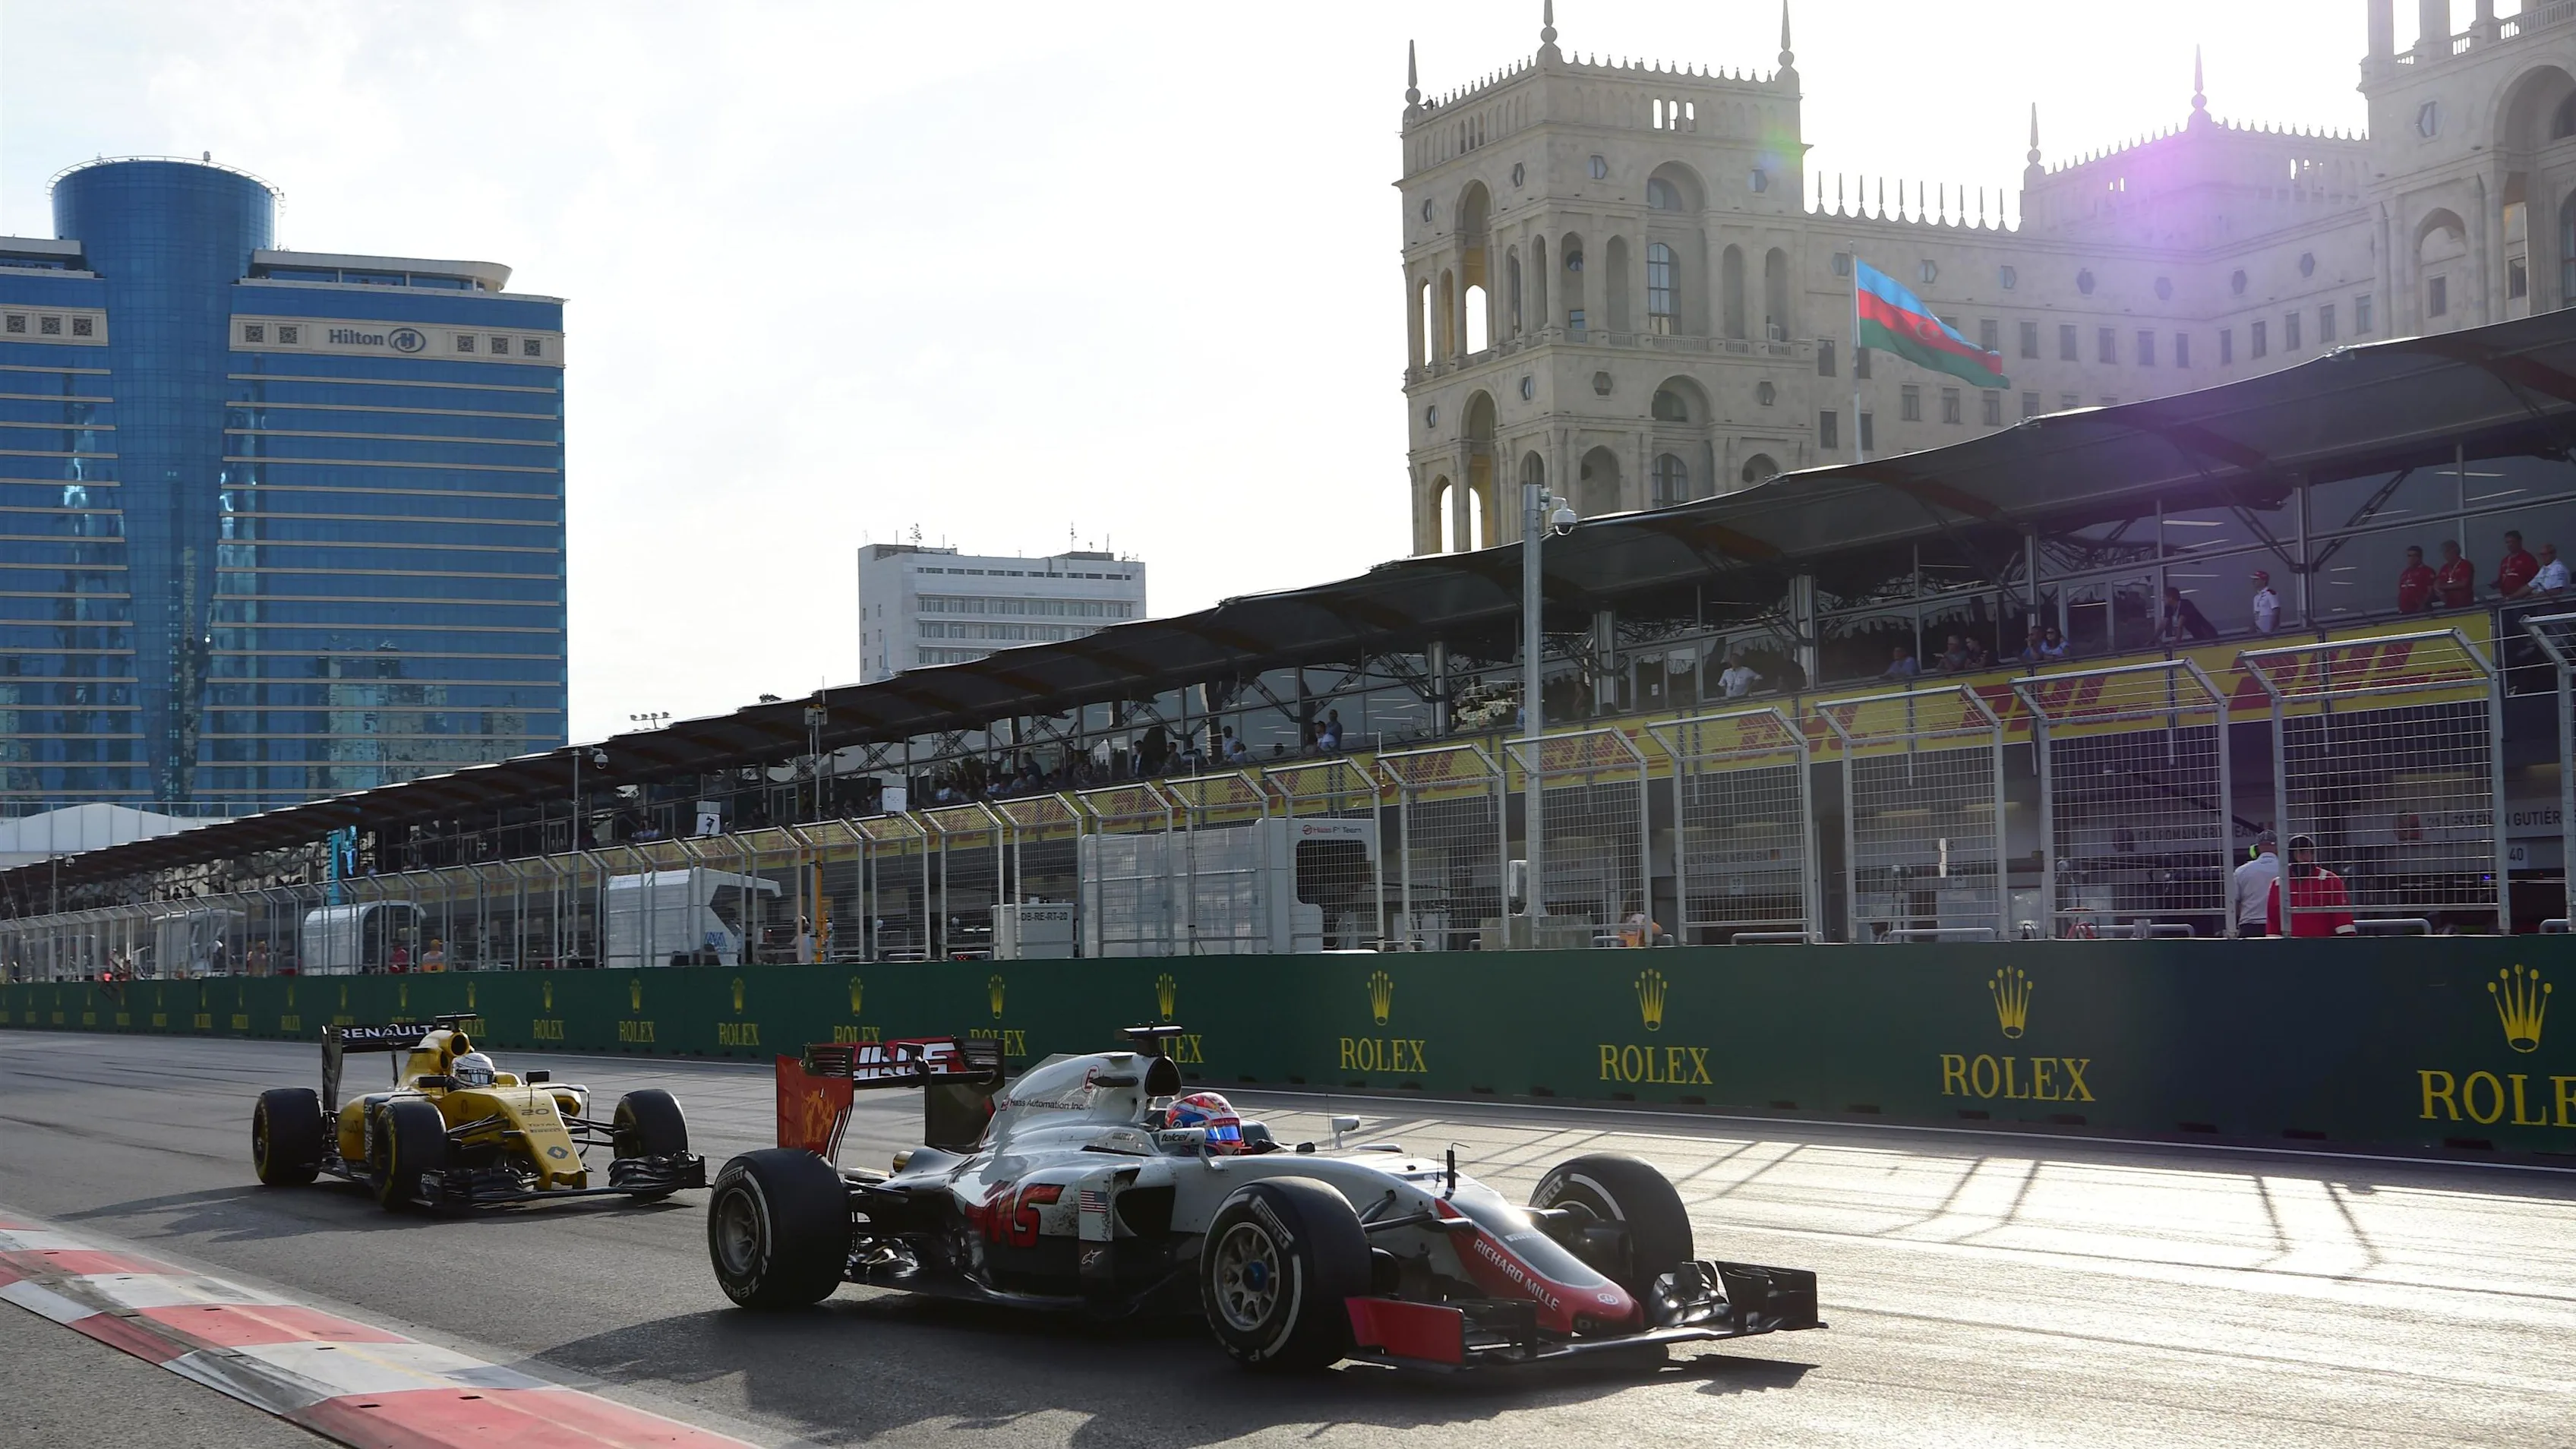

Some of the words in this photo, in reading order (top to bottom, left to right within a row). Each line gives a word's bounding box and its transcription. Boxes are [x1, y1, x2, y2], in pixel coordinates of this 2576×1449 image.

[329, 329, 384, 346] Hilton
[2514, 809, 2562, 827] GUTIÉR
[2508, 848, 2524, 861] 40
[341, 1025, 434, 1038] RENAULT
[619, 1021, 655, 1042] ROLEX
[718, 1023, 759, 1046] ROLEX
[1340, 1037, 1428, 1073] ROLEX
[1599, 1044, 1713, 1085] ROLEX
[1940, 1053, 2096, 1102] ROLEX
[1027, 1100, 1069, 1109] Automation
[2417, 1069, 2576, 1129] ROLE
[521, 1108, 550, 1116] 20
[1161, 1132, 1190, 1142] telcel
[1473, 1238, 1524, 1283] RICHARD
[1524, 1277, 1560, 1312] MILLE
